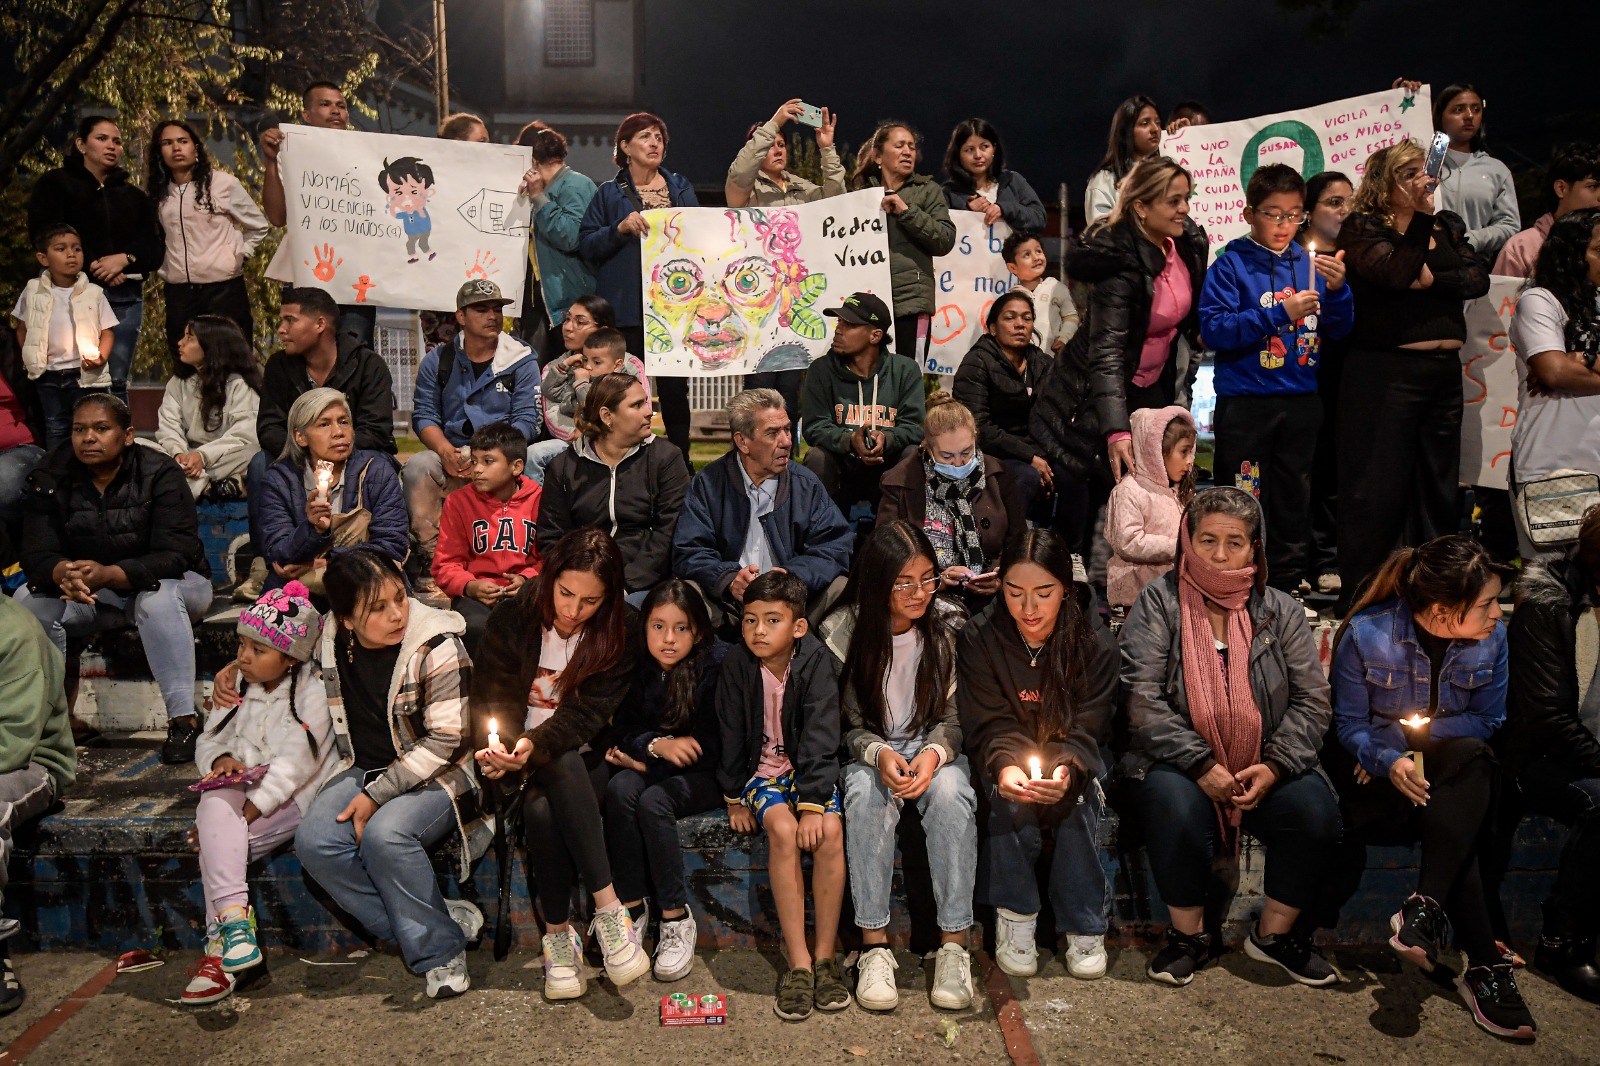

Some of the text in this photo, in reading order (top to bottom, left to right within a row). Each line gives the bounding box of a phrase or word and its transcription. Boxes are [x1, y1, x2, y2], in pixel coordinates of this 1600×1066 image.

[1324, 104, 1389, 128] VIGILA A
[1328, 120, 1402, 146] LOS NIÑOS
[1176, 140, 1229, 153] ME UNO
[1208, 153, 1224, 165] LA
[1331, 148, 1357, 163] QUE
[1205, 183, 1239, 194] CUIDA
[1193, 202, 1209, 212] TU
[301, 215, 311, 230] A
[822, 215, 883, 239] Piedra
[1207, 215, 1233, 226] SON
[834, 244, 886, 267] Viva
[845, 403, 897, 428] ANGELE
